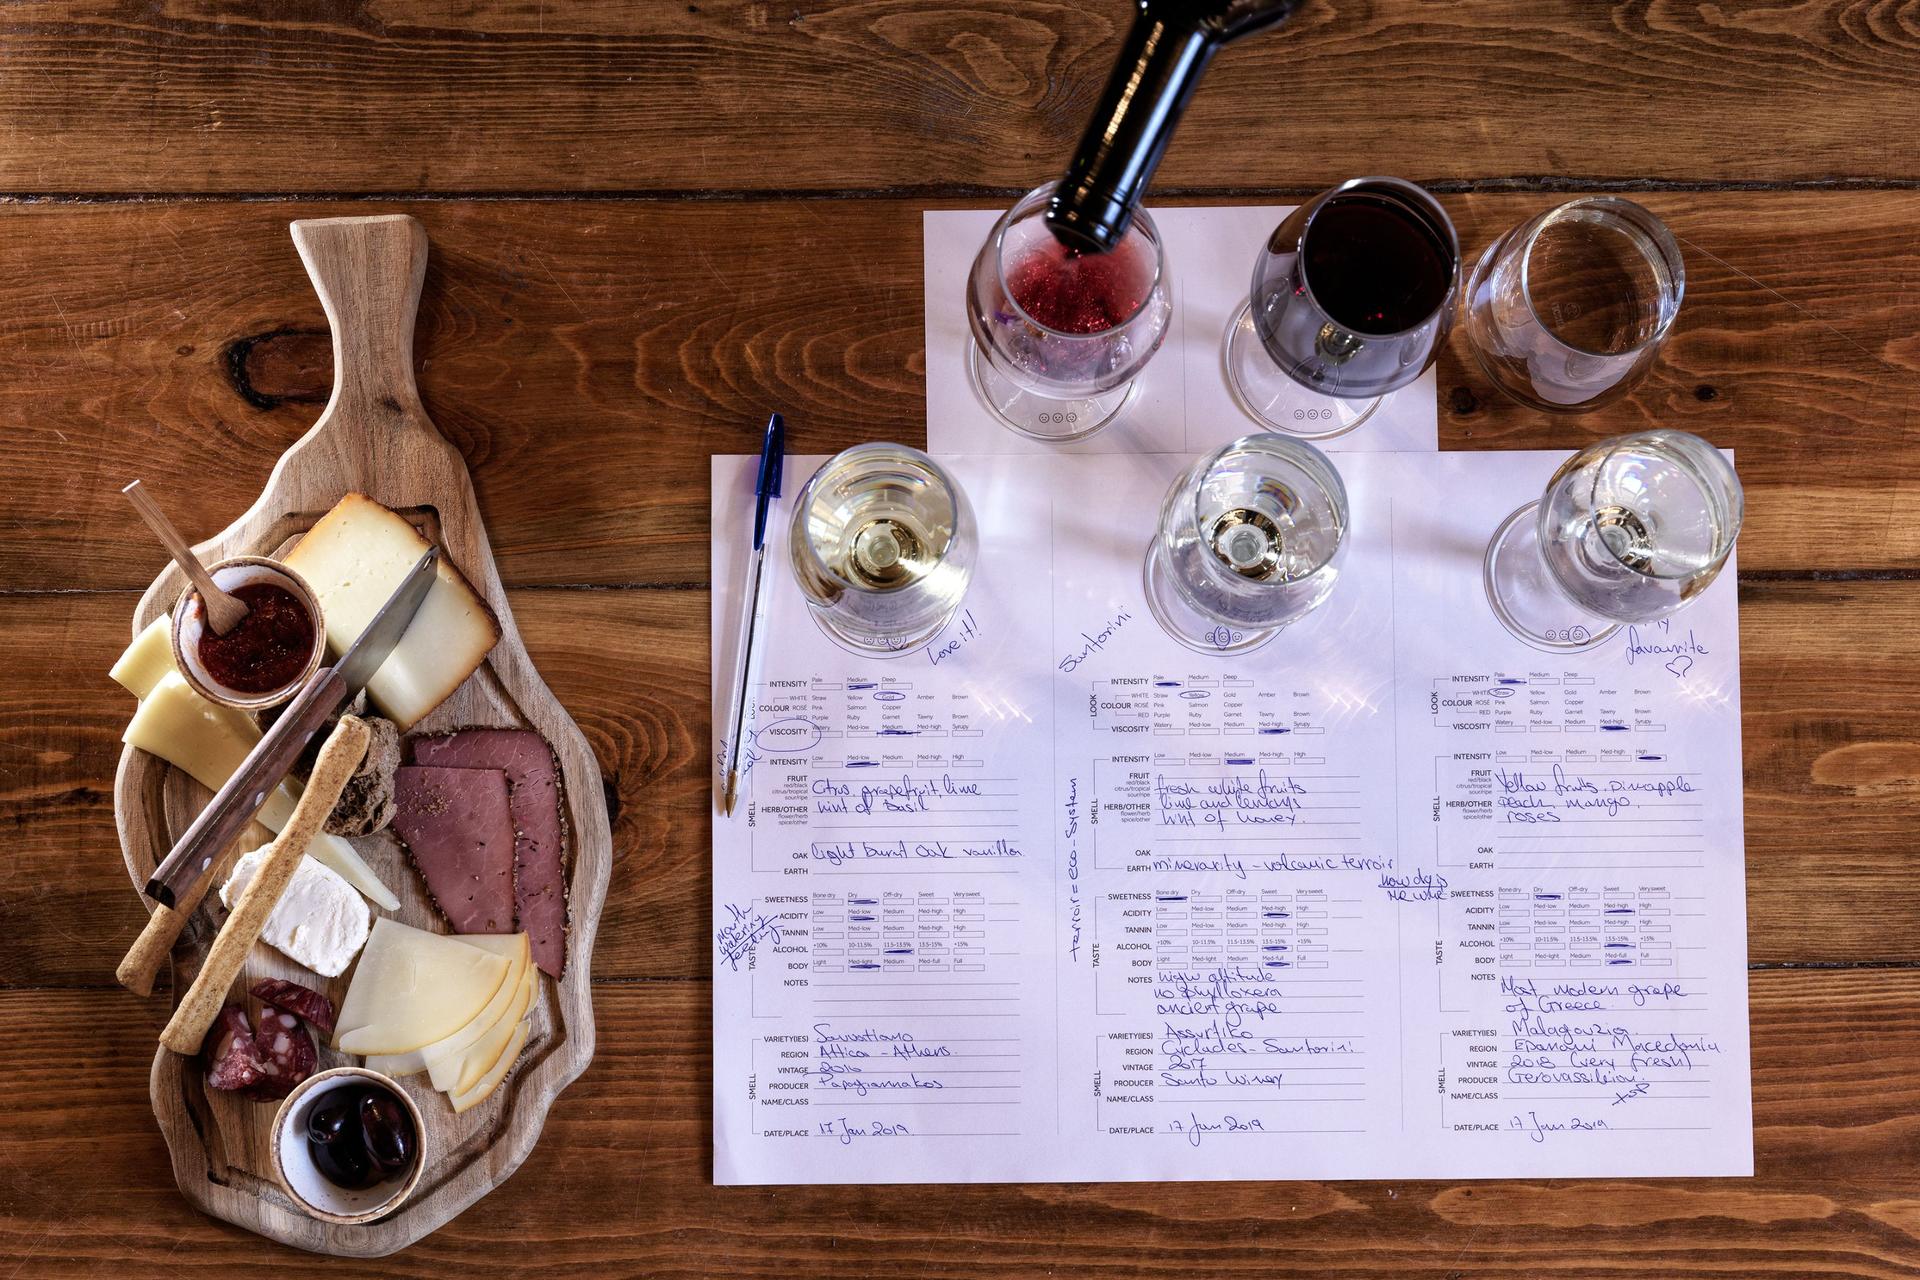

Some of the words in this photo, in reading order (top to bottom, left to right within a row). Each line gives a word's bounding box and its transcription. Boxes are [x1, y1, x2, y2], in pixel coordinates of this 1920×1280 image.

[769, 758, 808, 766] INTENSITY
[1471, 769, 1492, 777] FRUIT
[1446, 800, 1492, 808] HERB/OTHER
[748, 801, 756, 827] SMELL
[1469, 862, 1494, 870] EARTH
[1092, 943, 1100, 968] TASTE
[1435, 940, 1443, 965] TASTE
[1128, 976, 1152, 984] NOTES
[1125, 1048, 1154, 1056] REGION
[1469, 1045, 1497, 1053] REGION
[1113, 1079, 1154, 1087] PRODUCER
[1458, 1076, 1498, 1084] PRODUCER
[749, 1073, 757, 1100] SMELL
[1106, 1095, 1154, 1103] NAME/CLASS
[1451, 1092, 1498, 1100] NAME/CLASS
[1454, 1124, 1499, 1132] DATE/PLACE
